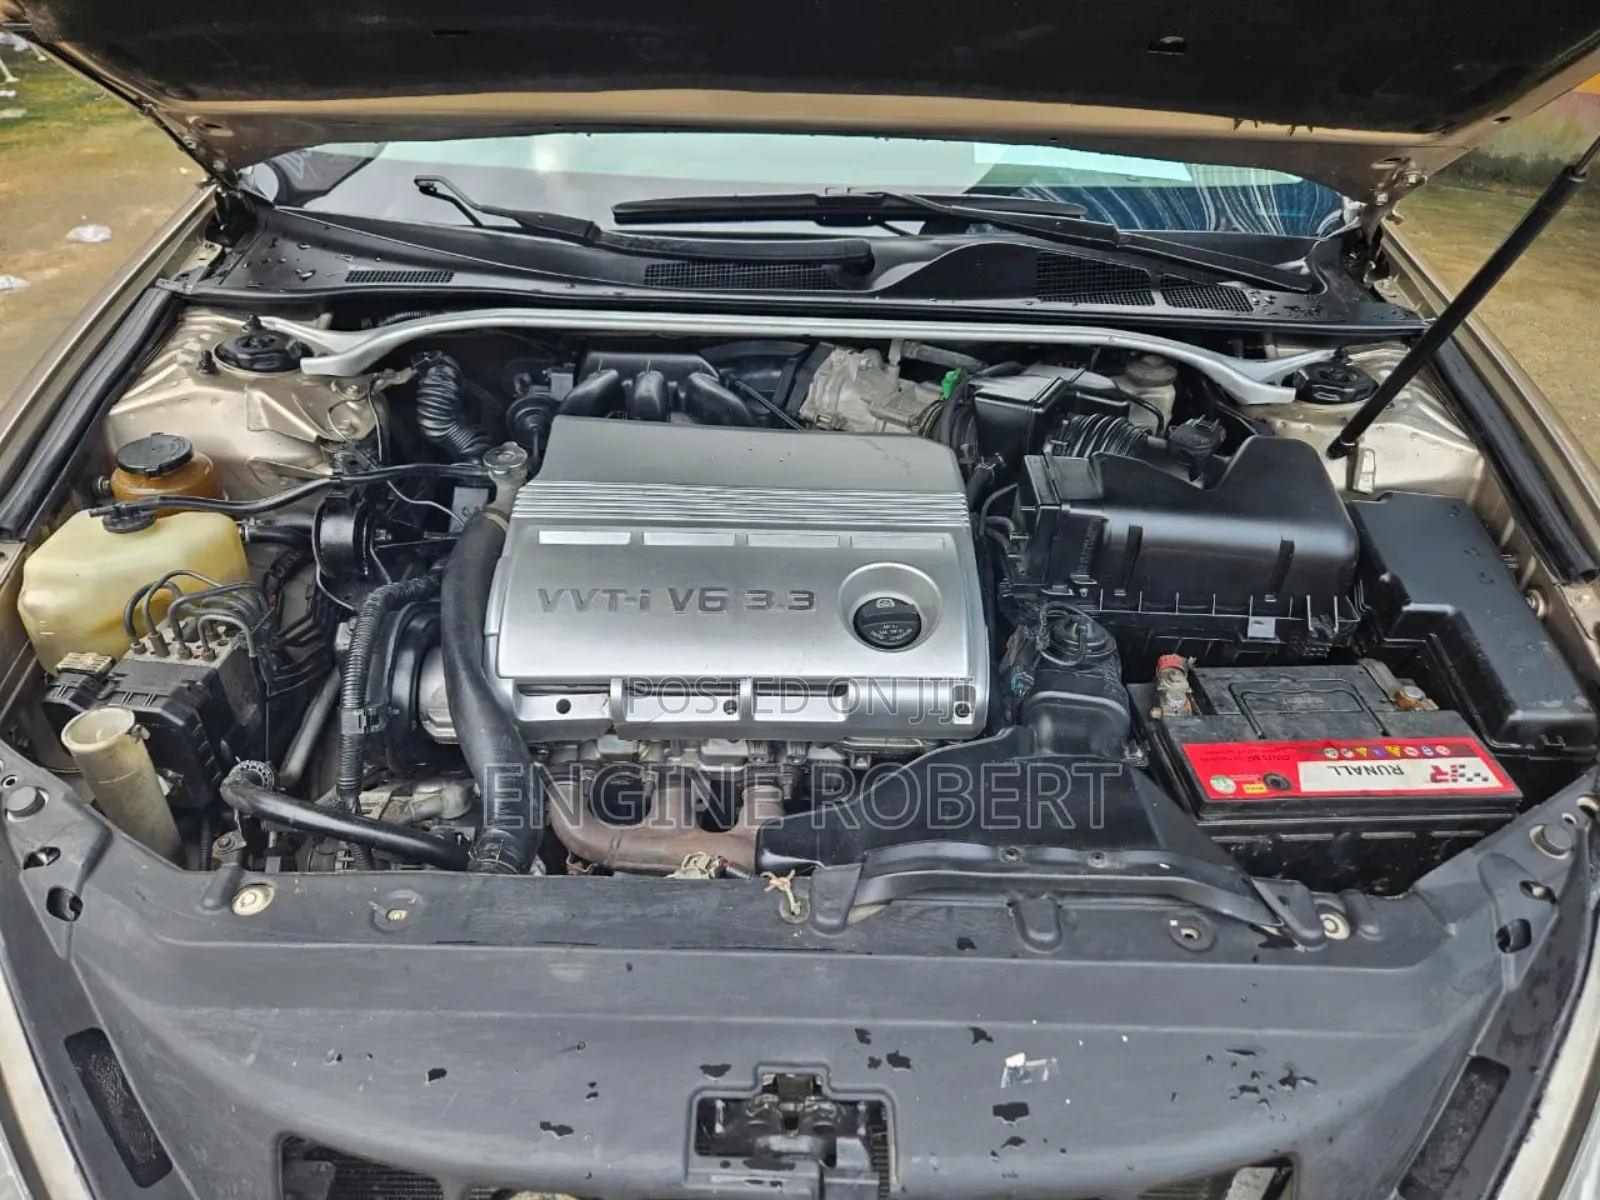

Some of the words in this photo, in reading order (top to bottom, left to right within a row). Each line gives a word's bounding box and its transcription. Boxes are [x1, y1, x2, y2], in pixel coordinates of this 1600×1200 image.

[536, 587, 651, 613] VVT-i
[667, 587, 729, 615] V6
[744, 589, 816, 612] 3.3
[1326, 764, 1405, 777] RUNALL
